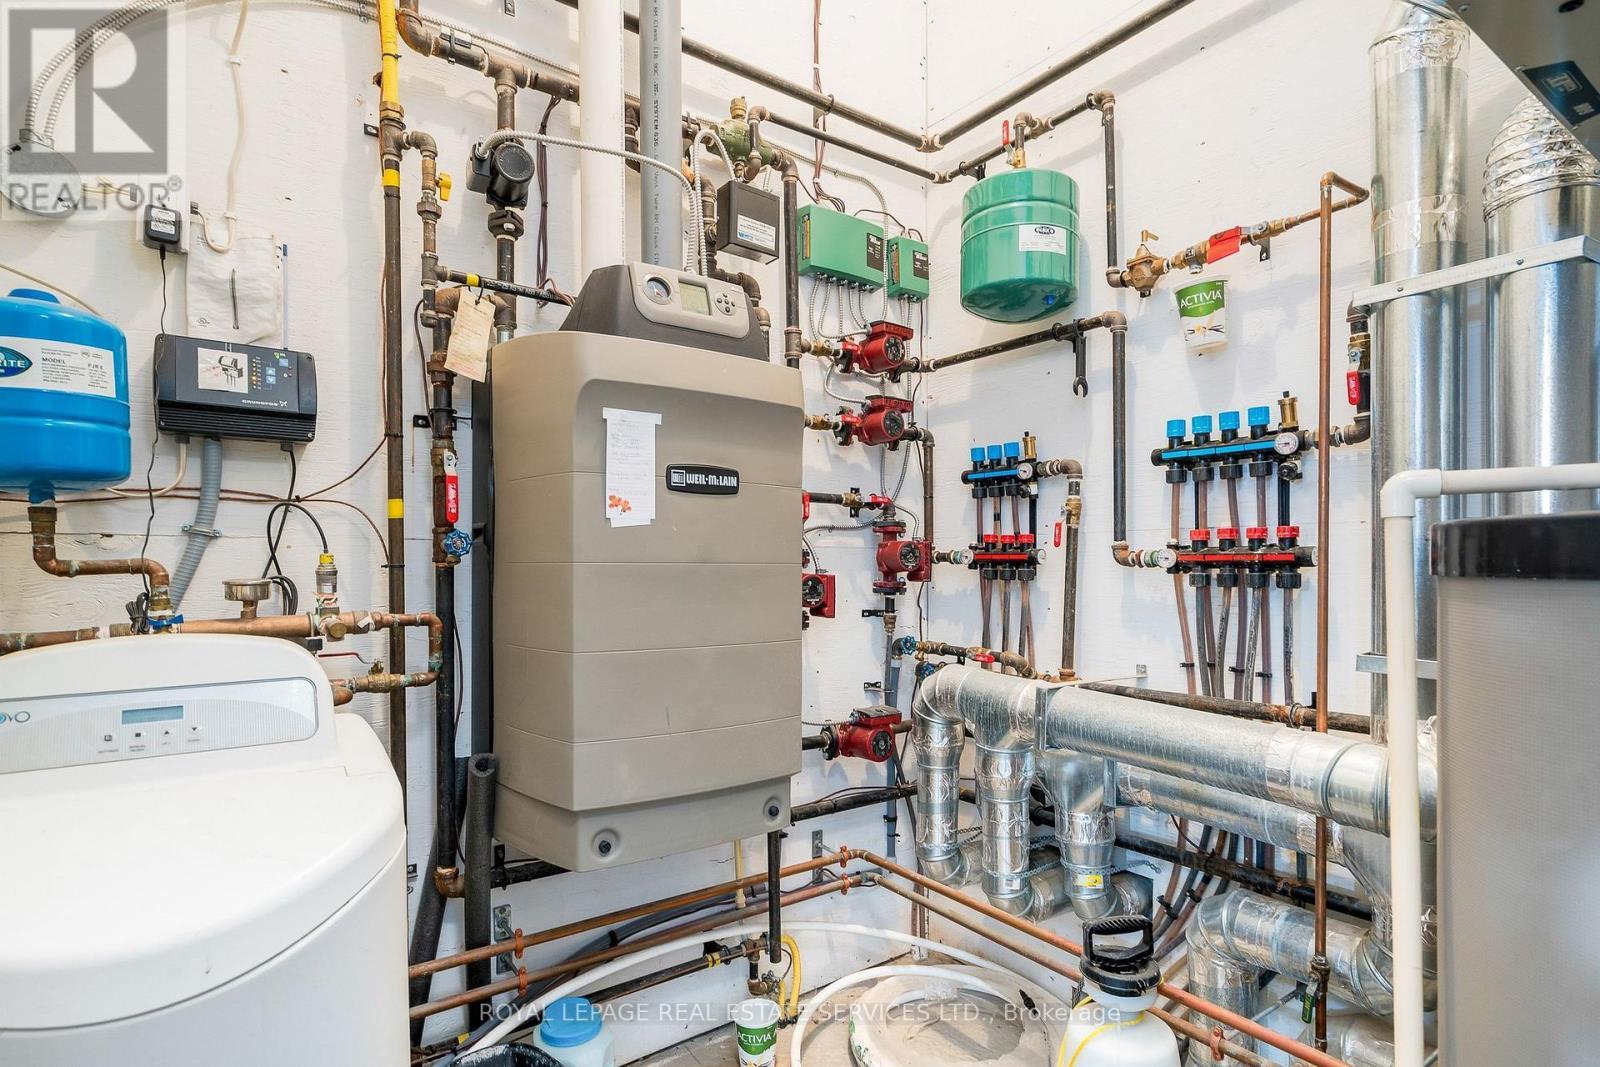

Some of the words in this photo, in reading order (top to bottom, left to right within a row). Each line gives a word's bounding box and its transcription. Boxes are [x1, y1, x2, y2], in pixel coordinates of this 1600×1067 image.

[652, 100, 660, 131] SYSTEM
[1180, 289, 1223, 308] ACTIVIA
[738, 1032, 772, 1044] ACTIVIA
